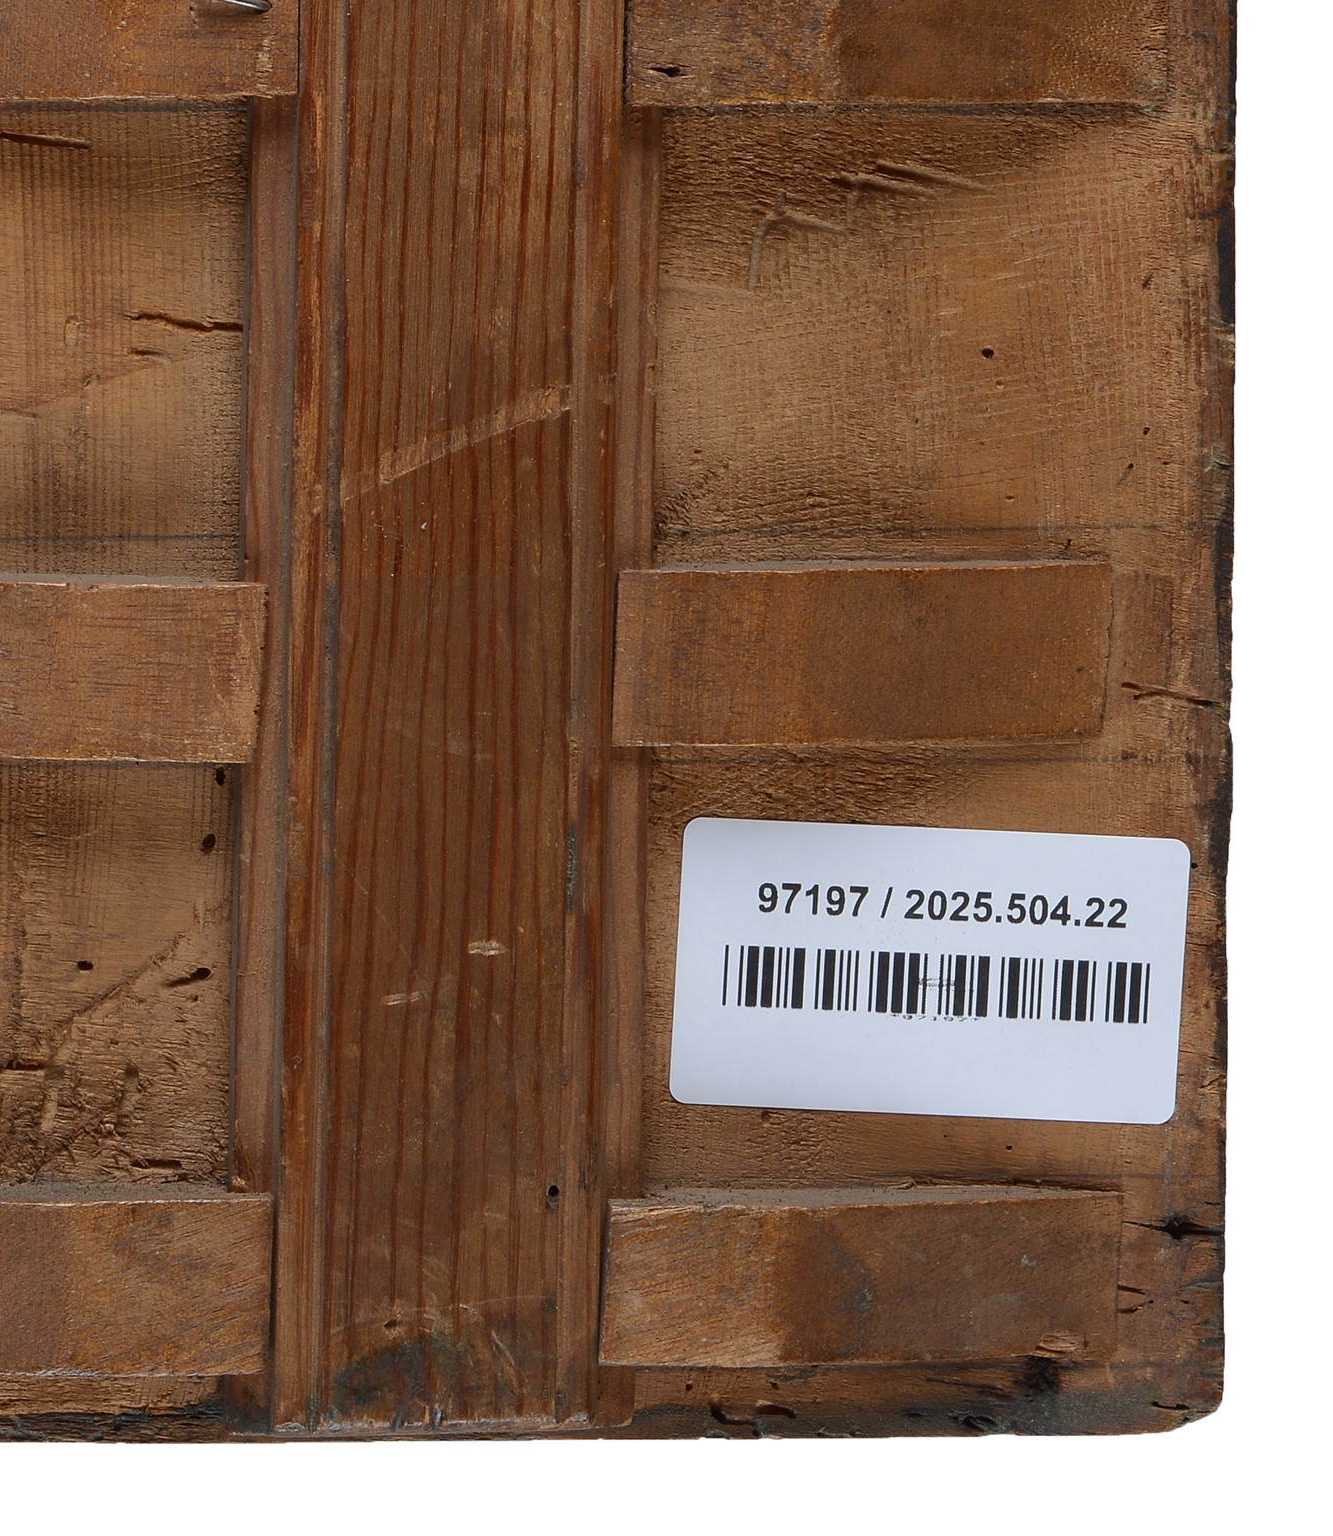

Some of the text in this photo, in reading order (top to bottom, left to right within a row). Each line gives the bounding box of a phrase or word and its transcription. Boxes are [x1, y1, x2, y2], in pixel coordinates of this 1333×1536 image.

[757, 882, 1129, 930] 97197 / 2025.504.22
